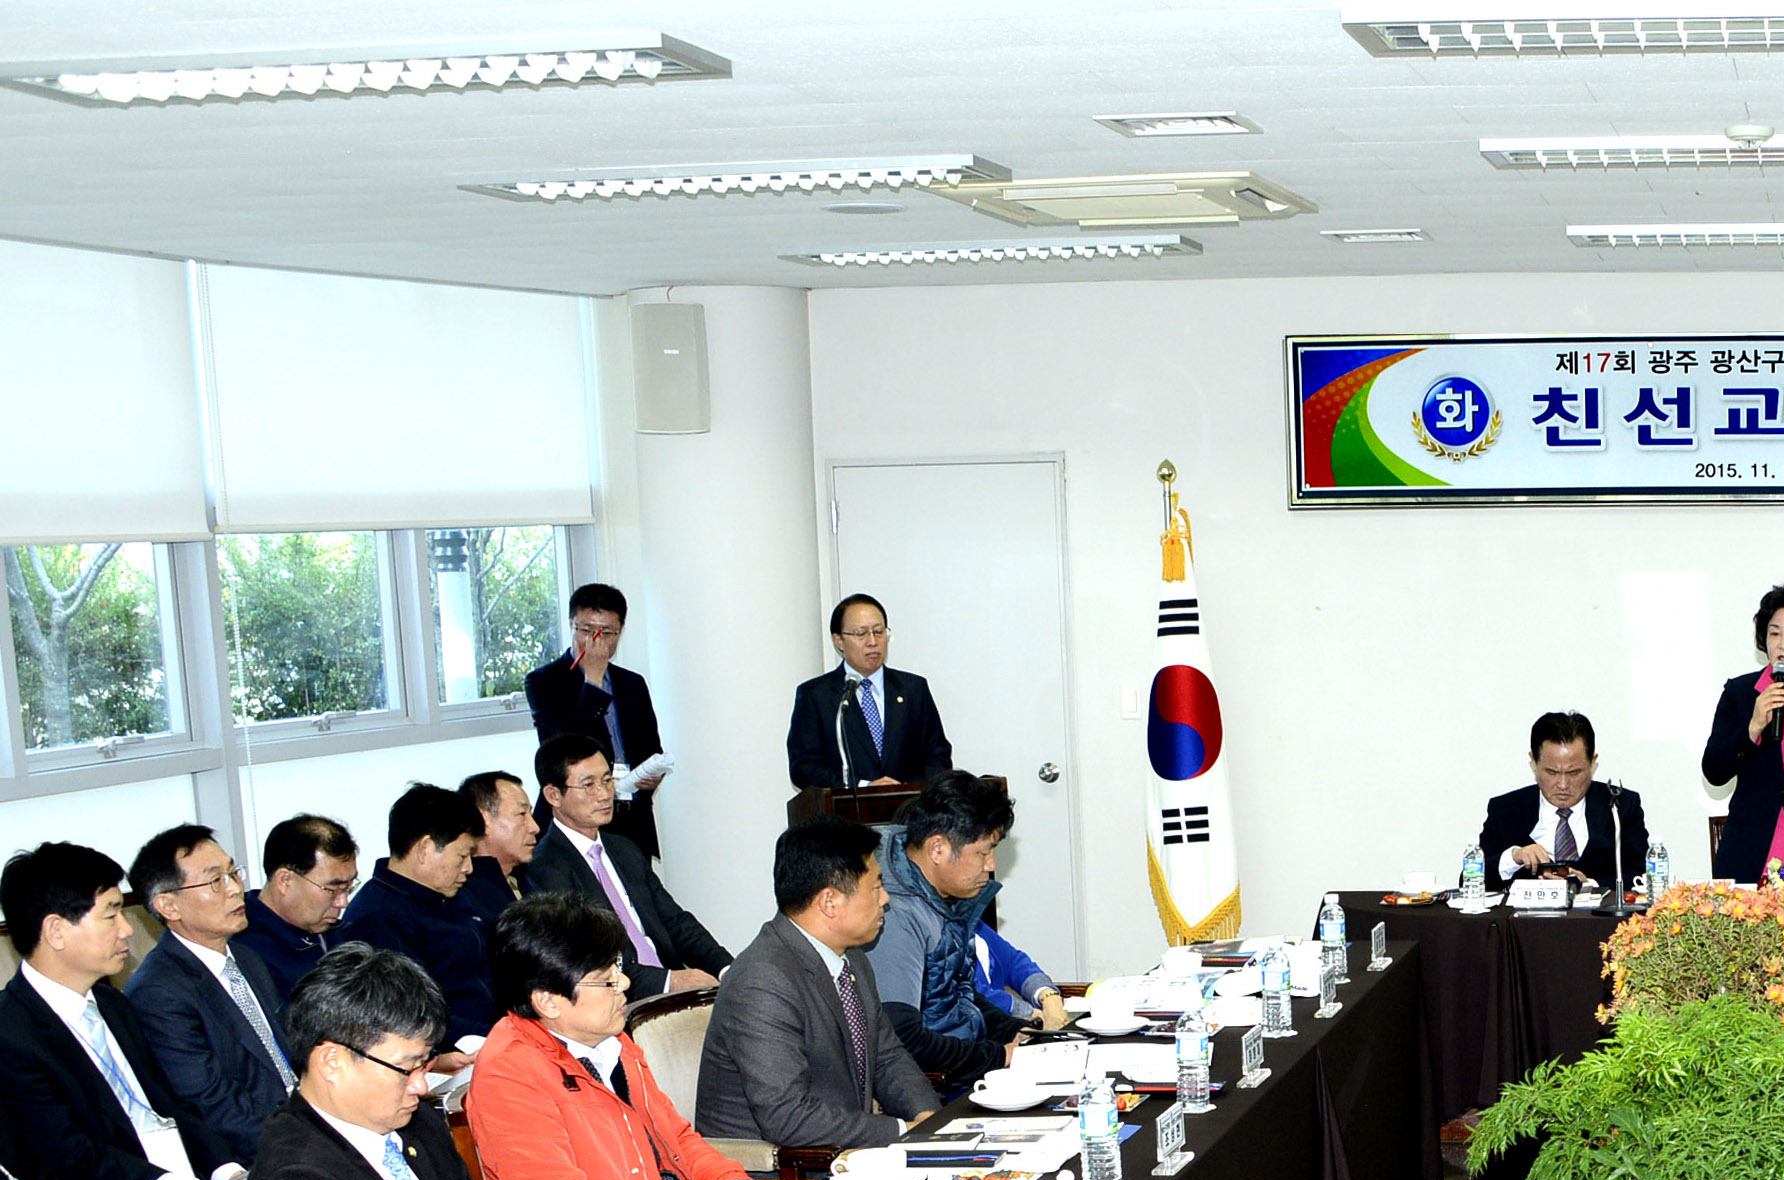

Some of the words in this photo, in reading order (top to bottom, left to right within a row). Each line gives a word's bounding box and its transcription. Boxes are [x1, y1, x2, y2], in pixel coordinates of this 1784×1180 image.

[1555, 349, 1637, 375] 제17회
[1648, 349, 1699, 375] 광주
[1435, 387, 1479, 432] 화
[1694, 462, 1742, 479] 2015.
[1750, 462, 1776, 479] 11.
